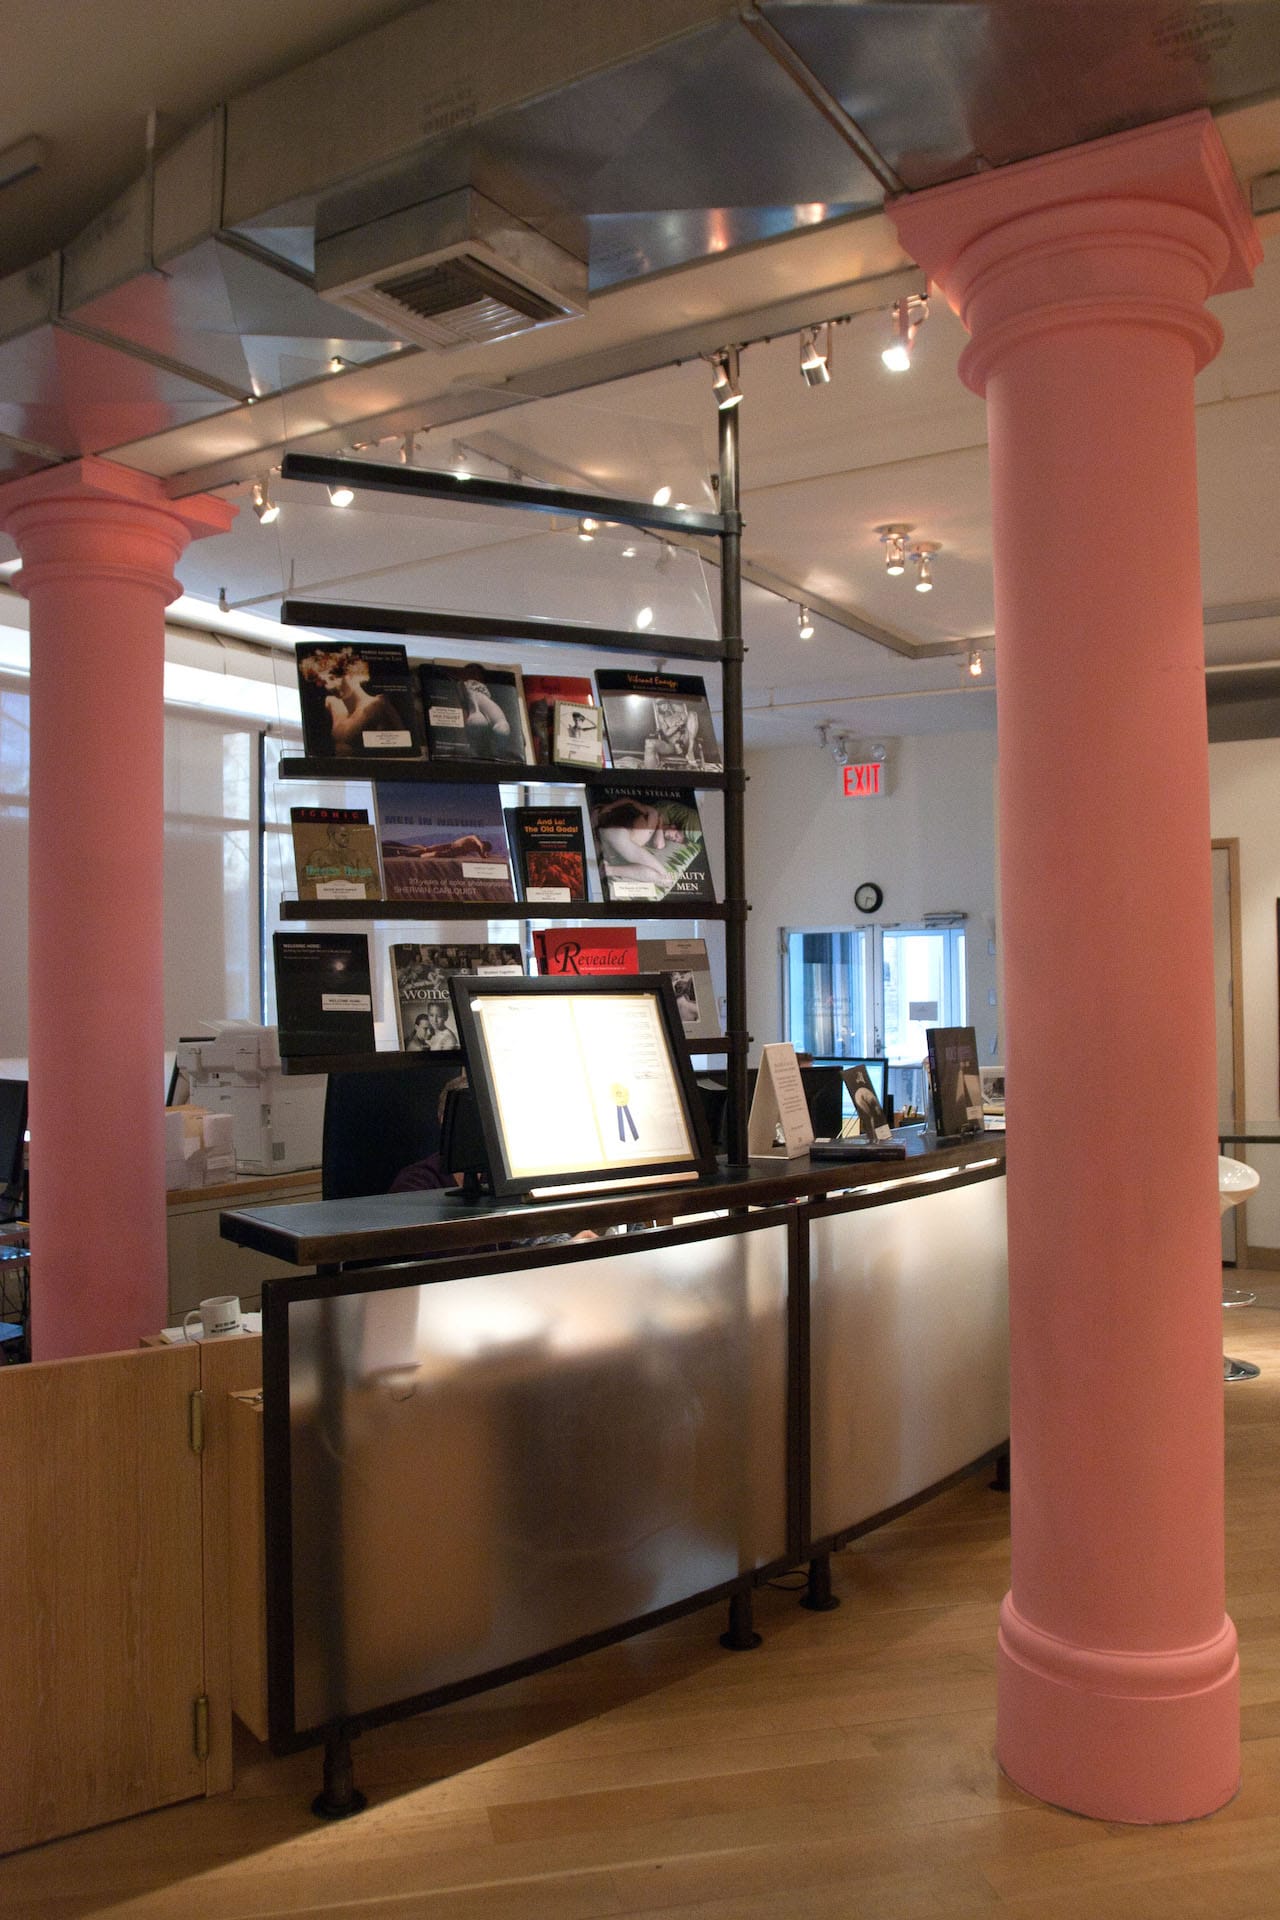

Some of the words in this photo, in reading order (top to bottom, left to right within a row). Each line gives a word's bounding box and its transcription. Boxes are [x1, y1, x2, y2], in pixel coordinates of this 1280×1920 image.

[843, 763, 881, 798] EXIT
[603, 787, 642, 796] STANLEY
[645, 789, 682, 799] STELLAR
[301, 808, 360, 819] ICONIC
[385, 815, 414, 825] MEN
[418, 816, 433, 826] IN
[437, 818, 484, 828] NATURE
[676, 882, 699, 891] MEN
[554, 941, 628, 975] Revealed
[403, 988, 451, 1001] wome
